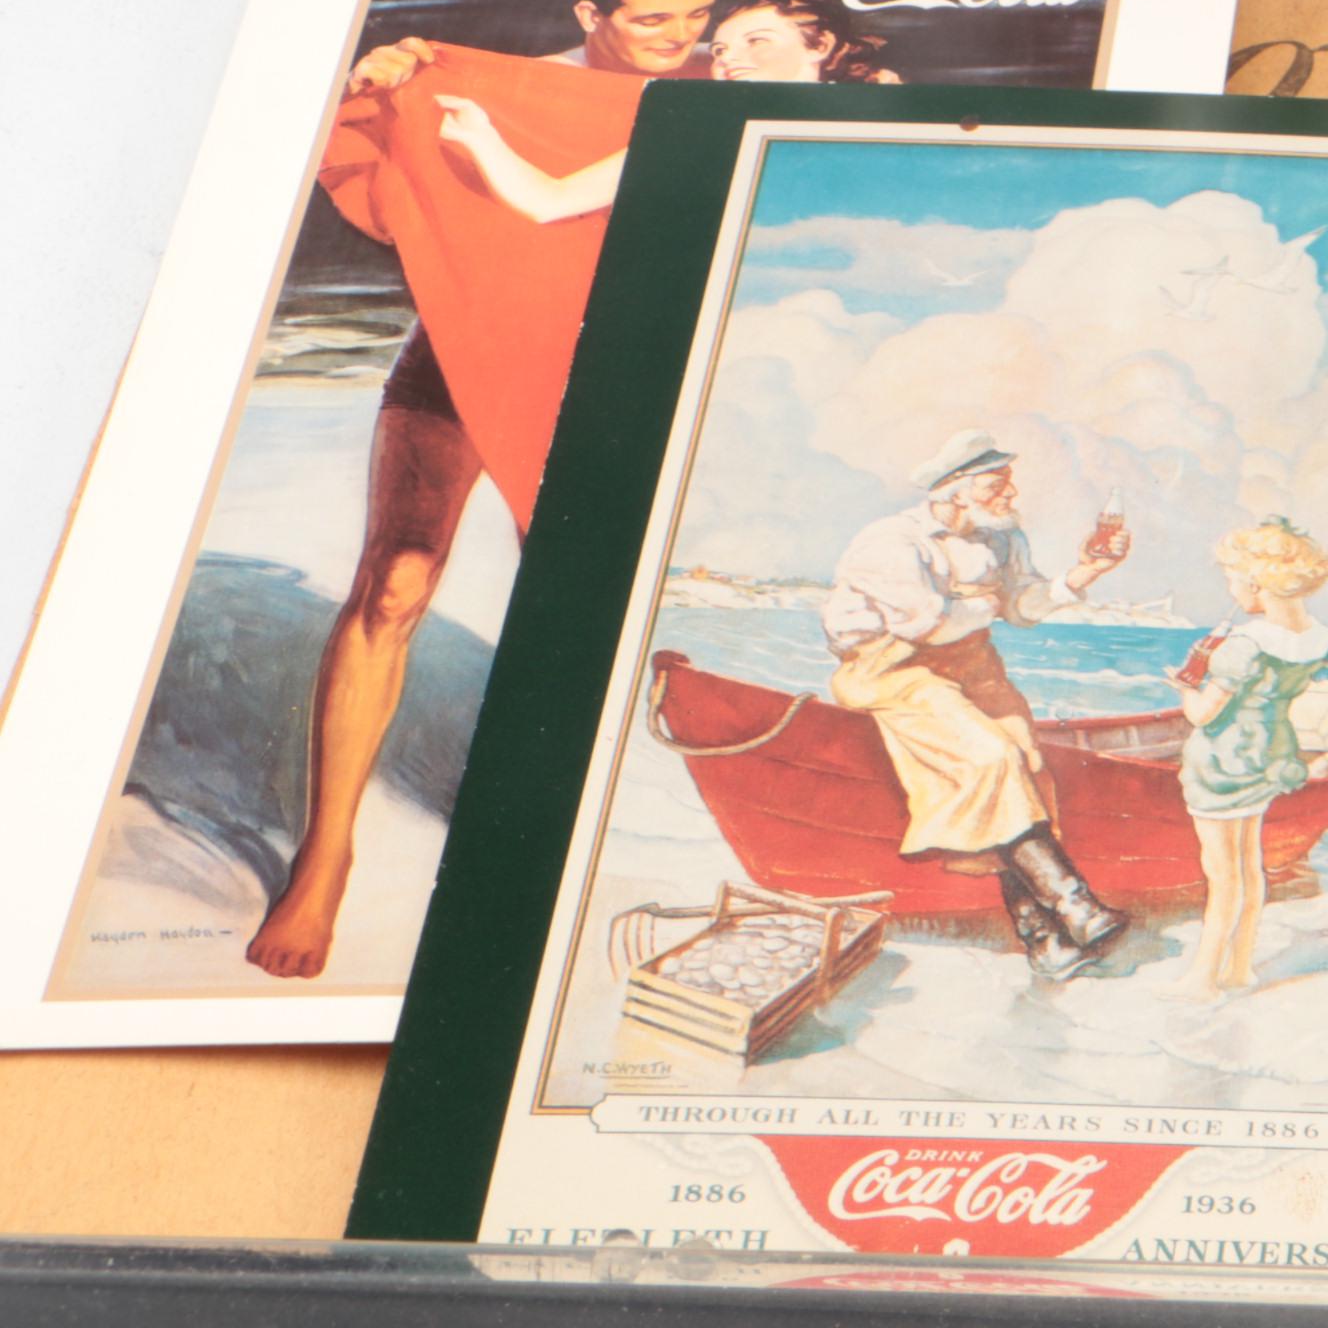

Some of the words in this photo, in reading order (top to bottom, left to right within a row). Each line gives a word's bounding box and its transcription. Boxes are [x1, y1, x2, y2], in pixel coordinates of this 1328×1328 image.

[639, 1104, 801, 1125] THROUGH
[817, 1107, 880, 1126] ALL
[899, 1109, 967, 1129] THE
[988, 1112, 1102, 1133] YEARS
[1123, 1114, 1223, 1138] SINCE
[1245, 1118, 1320, 1141] 1886
[904, 1148, 984, 1163] DRINK
[668, 1183, 747, 1204] 1886
[828, 1150, 1108, 1227] Coca-Cola
[1180, 1194, 1257, 1217] 1936
